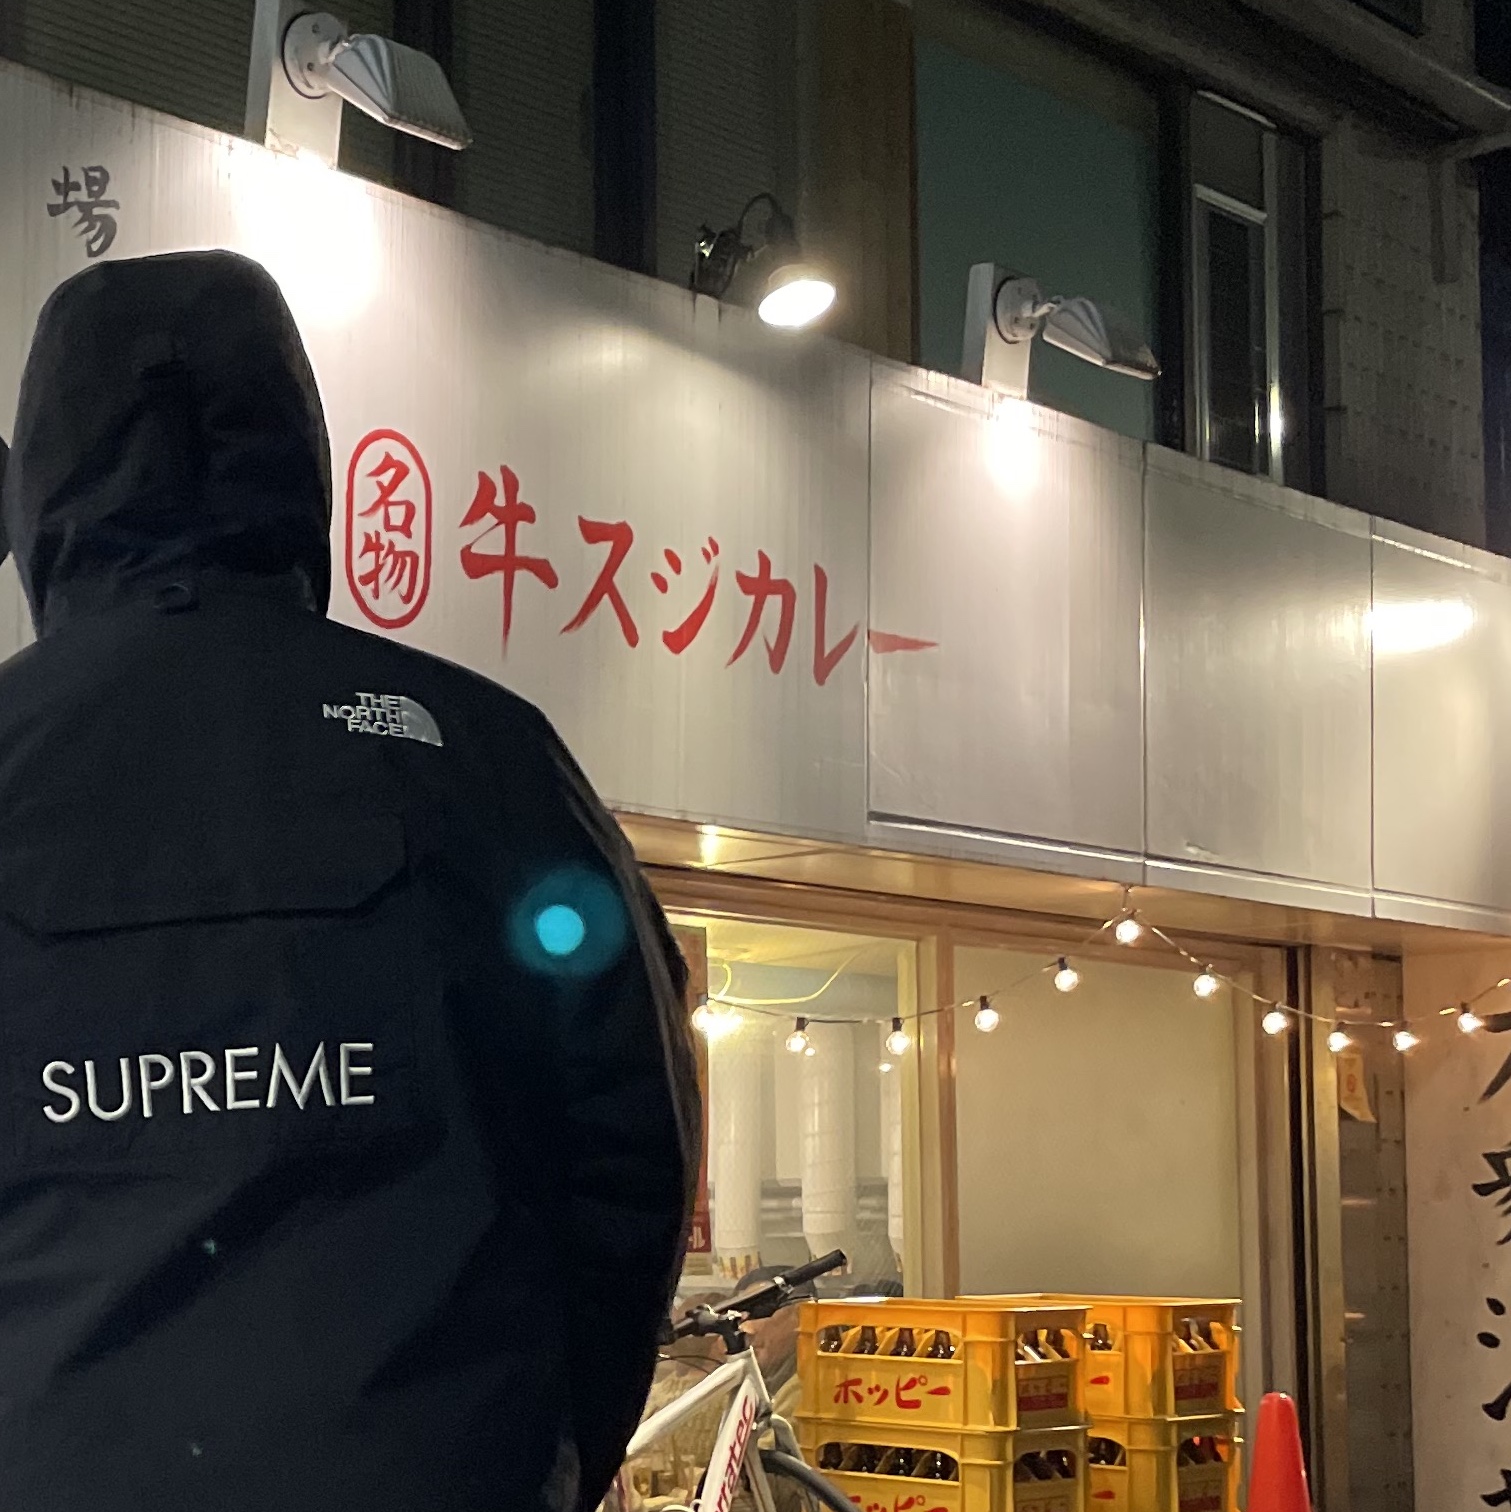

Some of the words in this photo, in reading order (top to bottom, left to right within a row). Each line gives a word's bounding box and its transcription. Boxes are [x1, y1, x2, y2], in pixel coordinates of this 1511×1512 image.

[358, 451, 419, 607] 名物
[460, 465, 939, 685] 牛スジカレー
[322, 704, 402, 724] NORTH
[355, 691, 402, 709] THE
[348, 718, 405, 738] FACE
[42, 1041, 375, 1123] SUPREME
[834, 1374, 951, 1410] ホッピー
